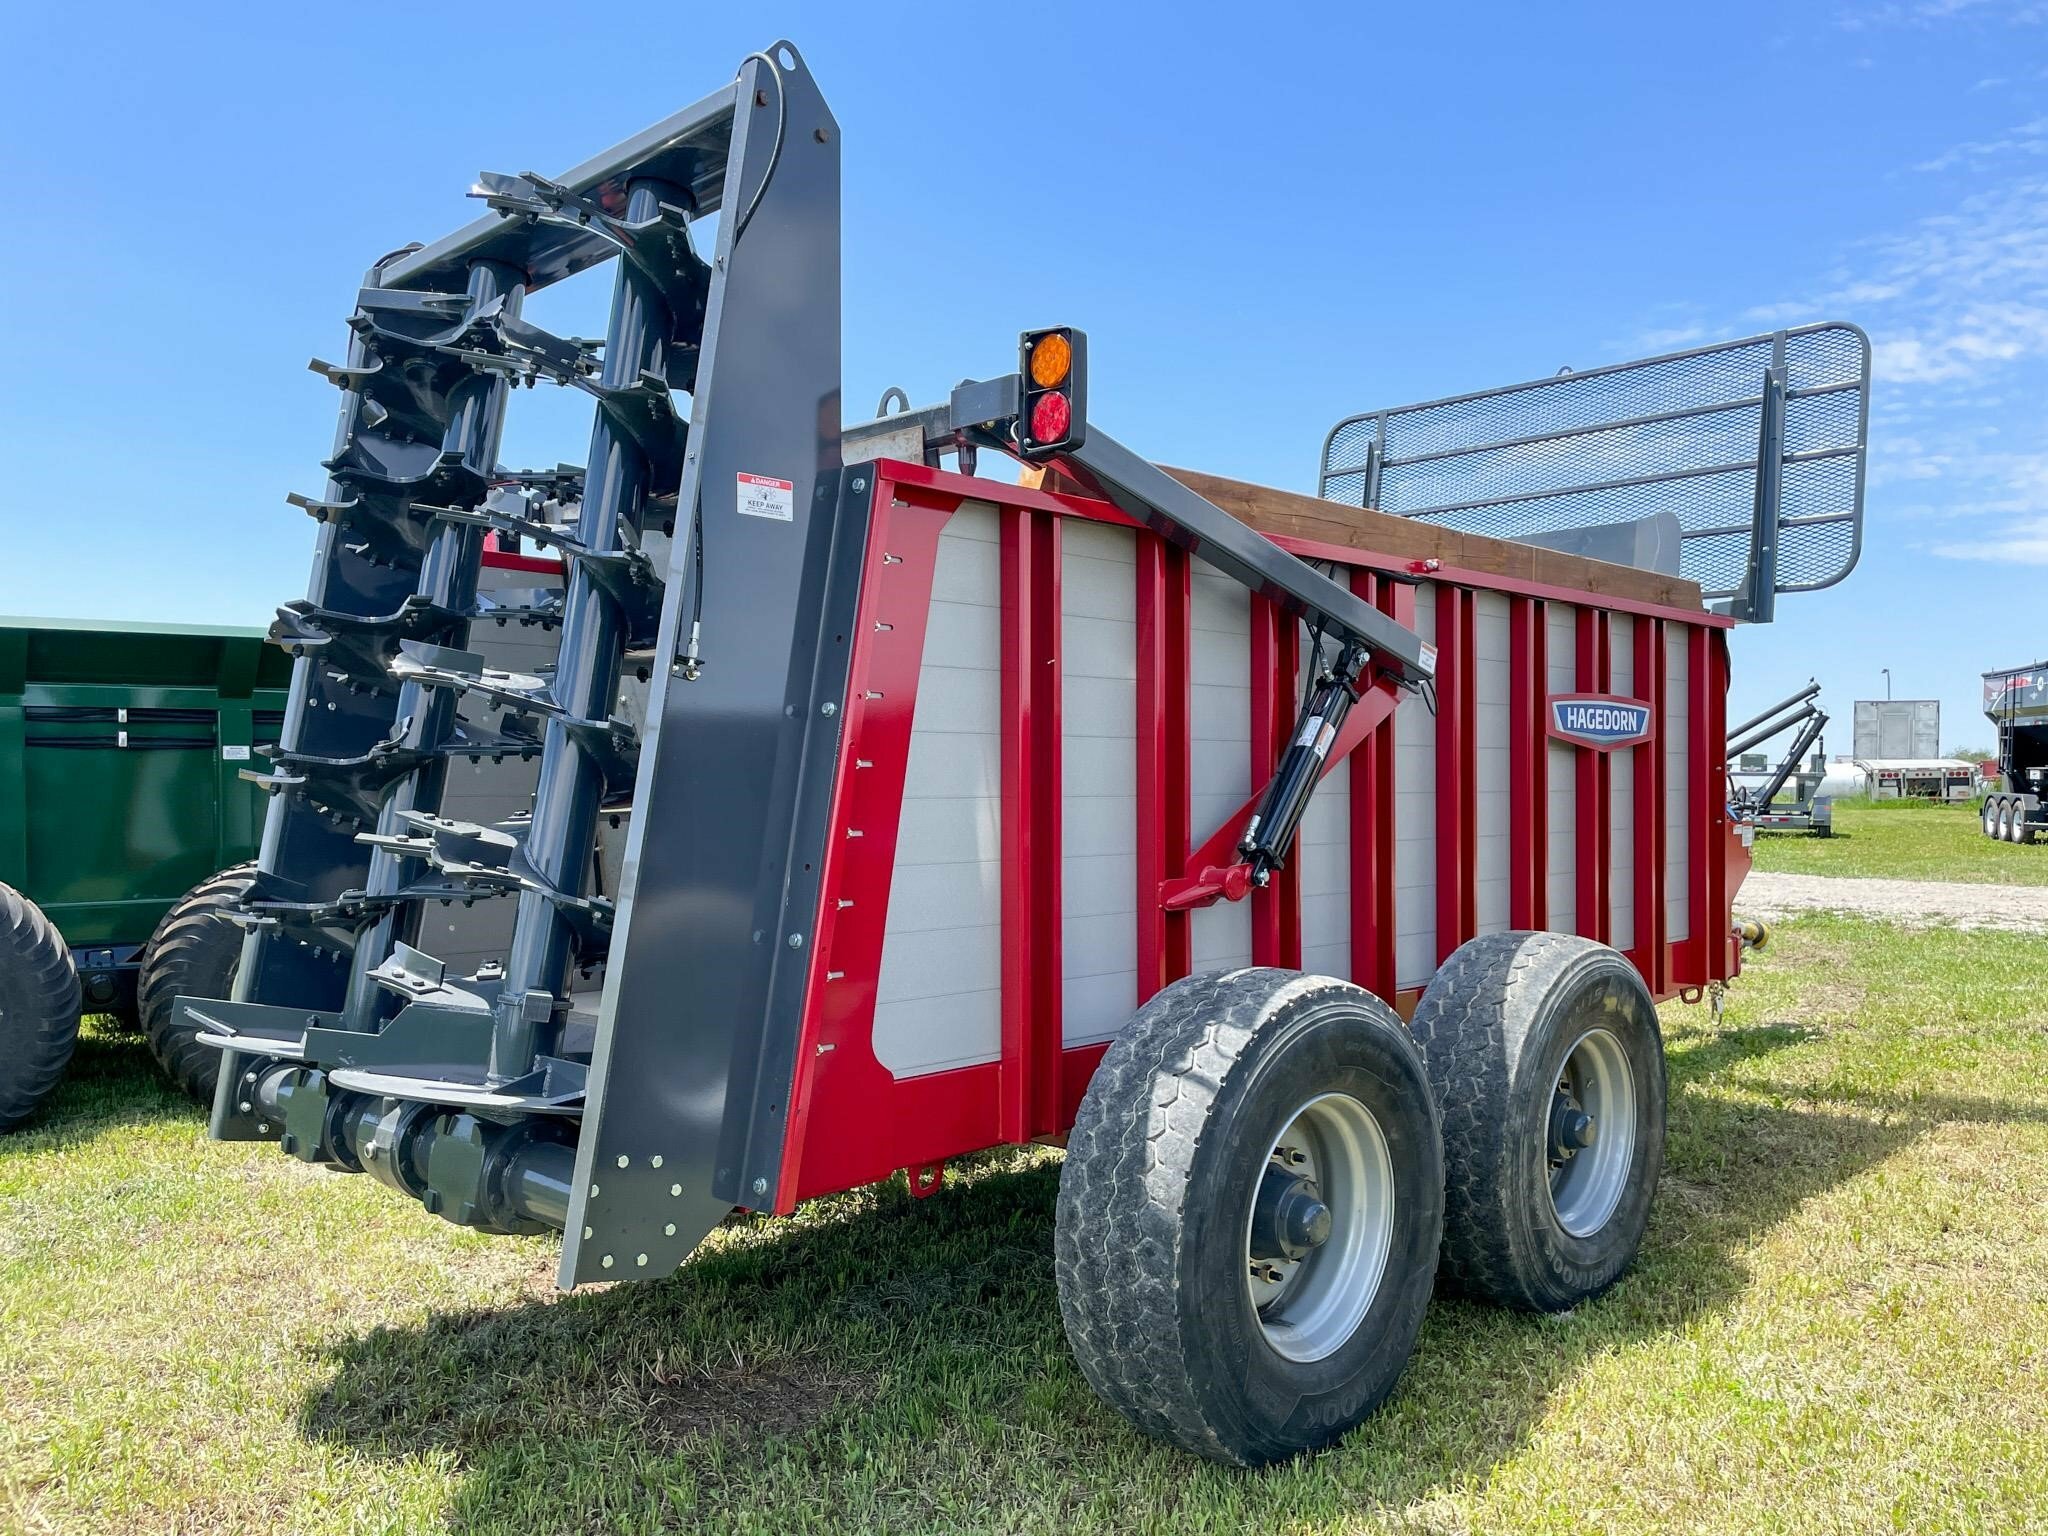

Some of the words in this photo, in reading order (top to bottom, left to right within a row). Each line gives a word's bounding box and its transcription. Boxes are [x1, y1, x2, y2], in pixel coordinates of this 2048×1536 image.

[755, 477, 781, 488] DANGER
[747, 500, 765, 508] KEEP
[765, 502, 783, 511] AWAY
[1567, 706, 1637, 731] HAGEDORN
